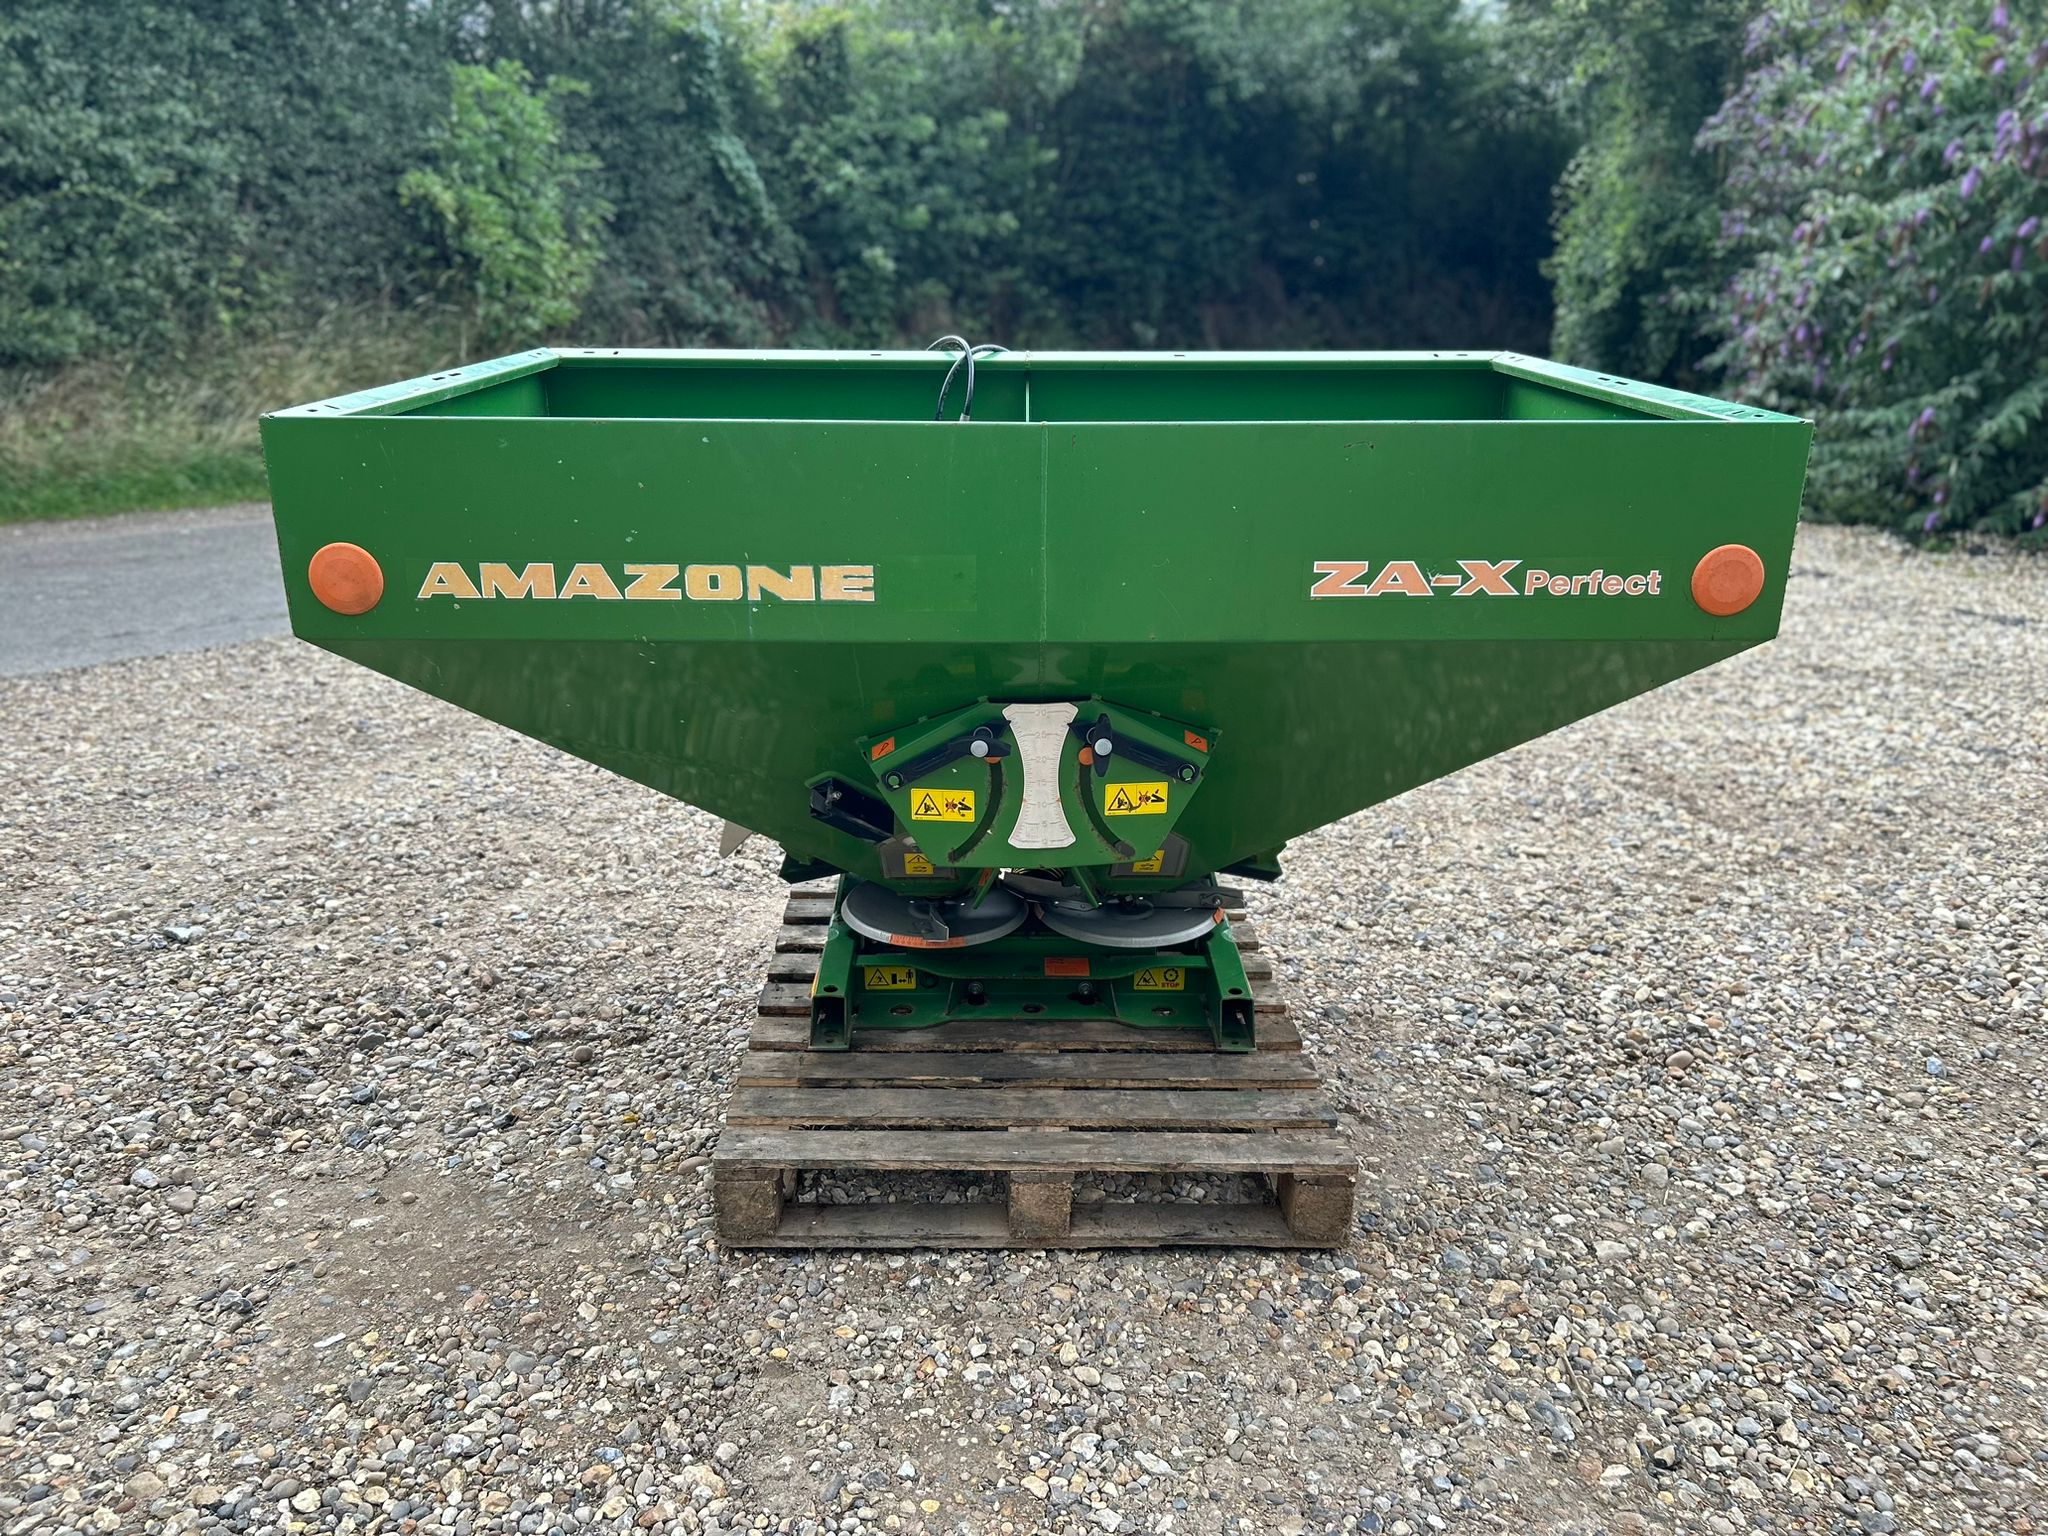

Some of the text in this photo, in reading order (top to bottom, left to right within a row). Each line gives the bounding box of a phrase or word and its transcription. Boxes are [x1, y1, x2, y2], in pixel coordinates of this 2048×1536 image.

[416, 562, 876, 602] AMAZONE
[1310, 559, 1663, 598] ZA-X Perfect
[1035, 730, 1047, 739] 25
[1035, 755, 1047, 764] 20
